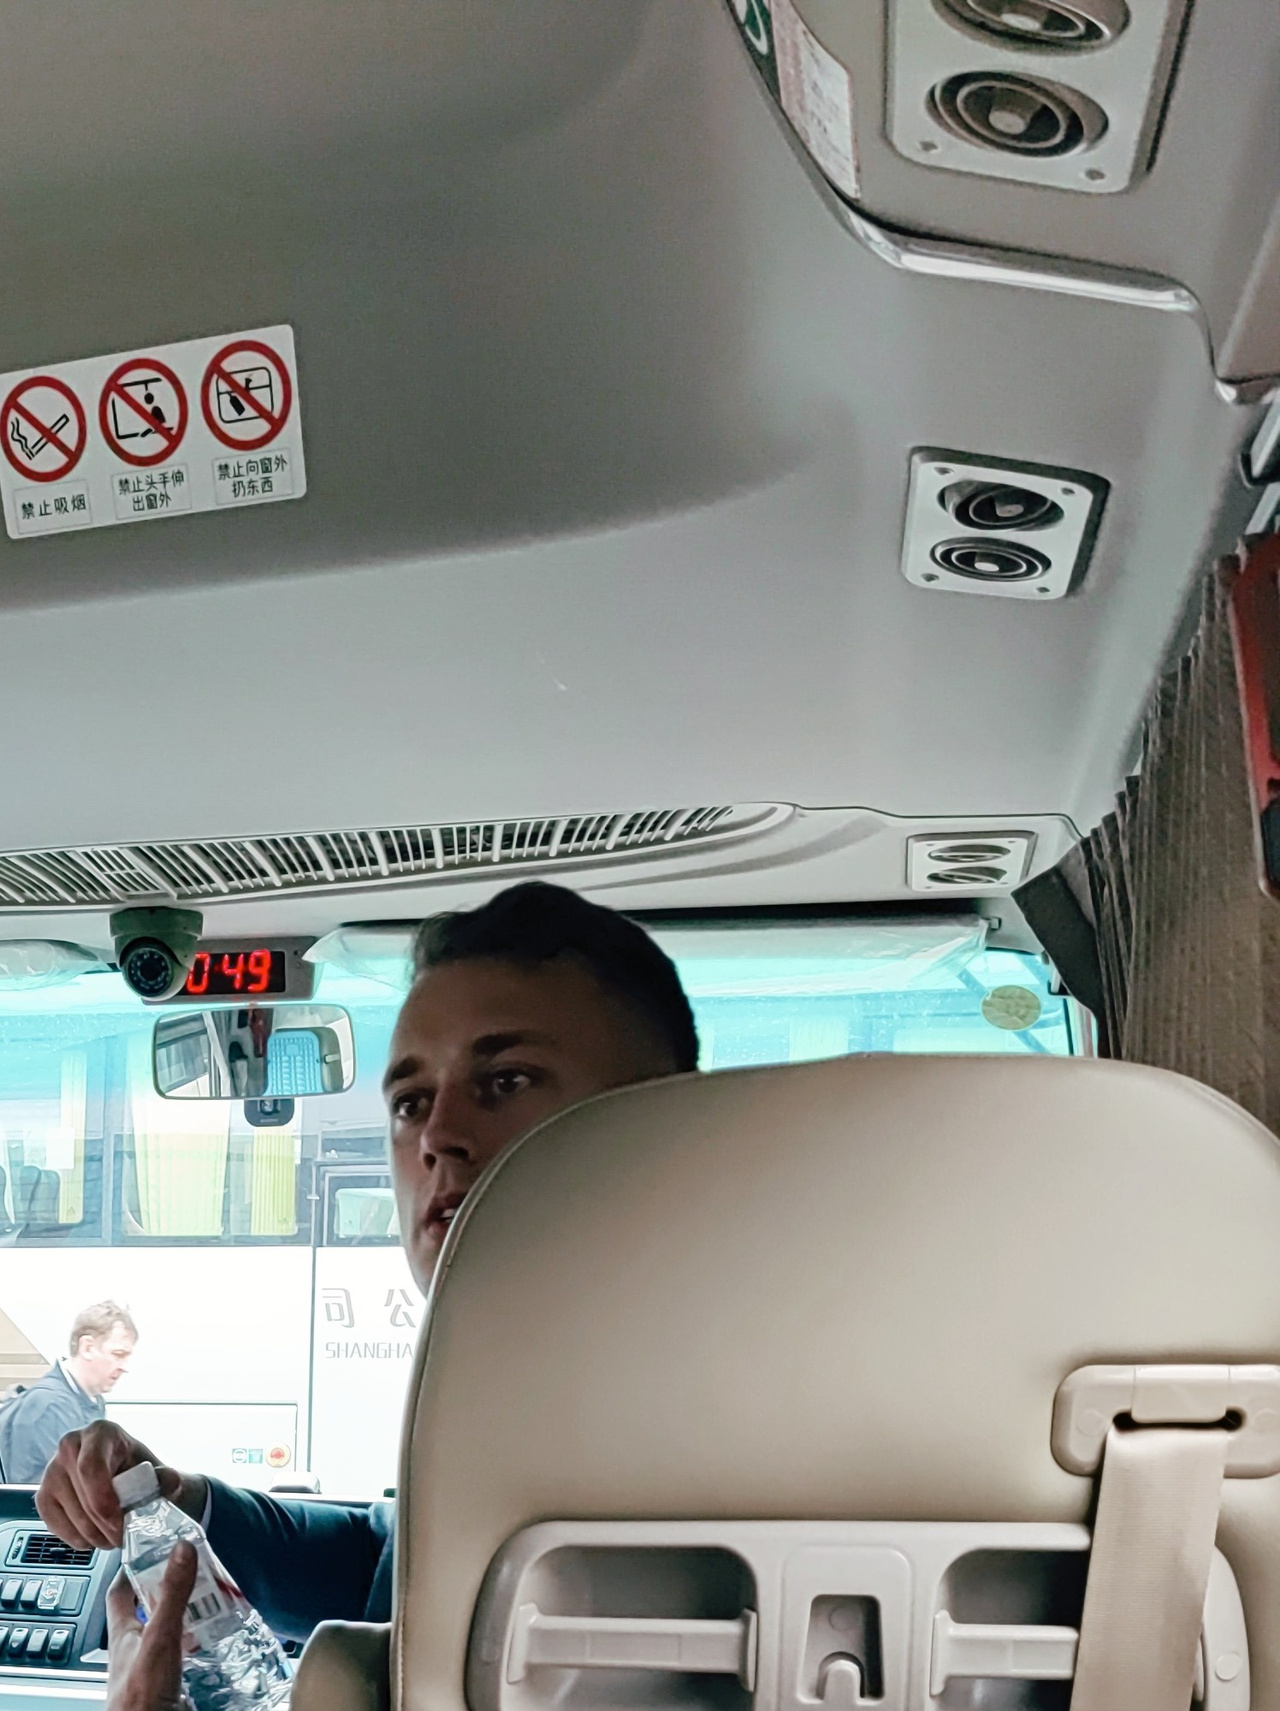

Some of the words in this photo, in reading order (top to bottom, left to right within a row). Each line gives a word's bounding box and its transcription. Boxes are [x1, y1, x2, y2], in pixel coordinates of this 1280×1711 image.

[218, 454, 288, 481] 禁止向窗外
[118, 469, 185, 496] 禁止头手伸
[231, 476, 274, 498] 扔东西
[21, 493, 87, 520] 禁止吸烟
[132, 491, 172, 512] 出窗外
